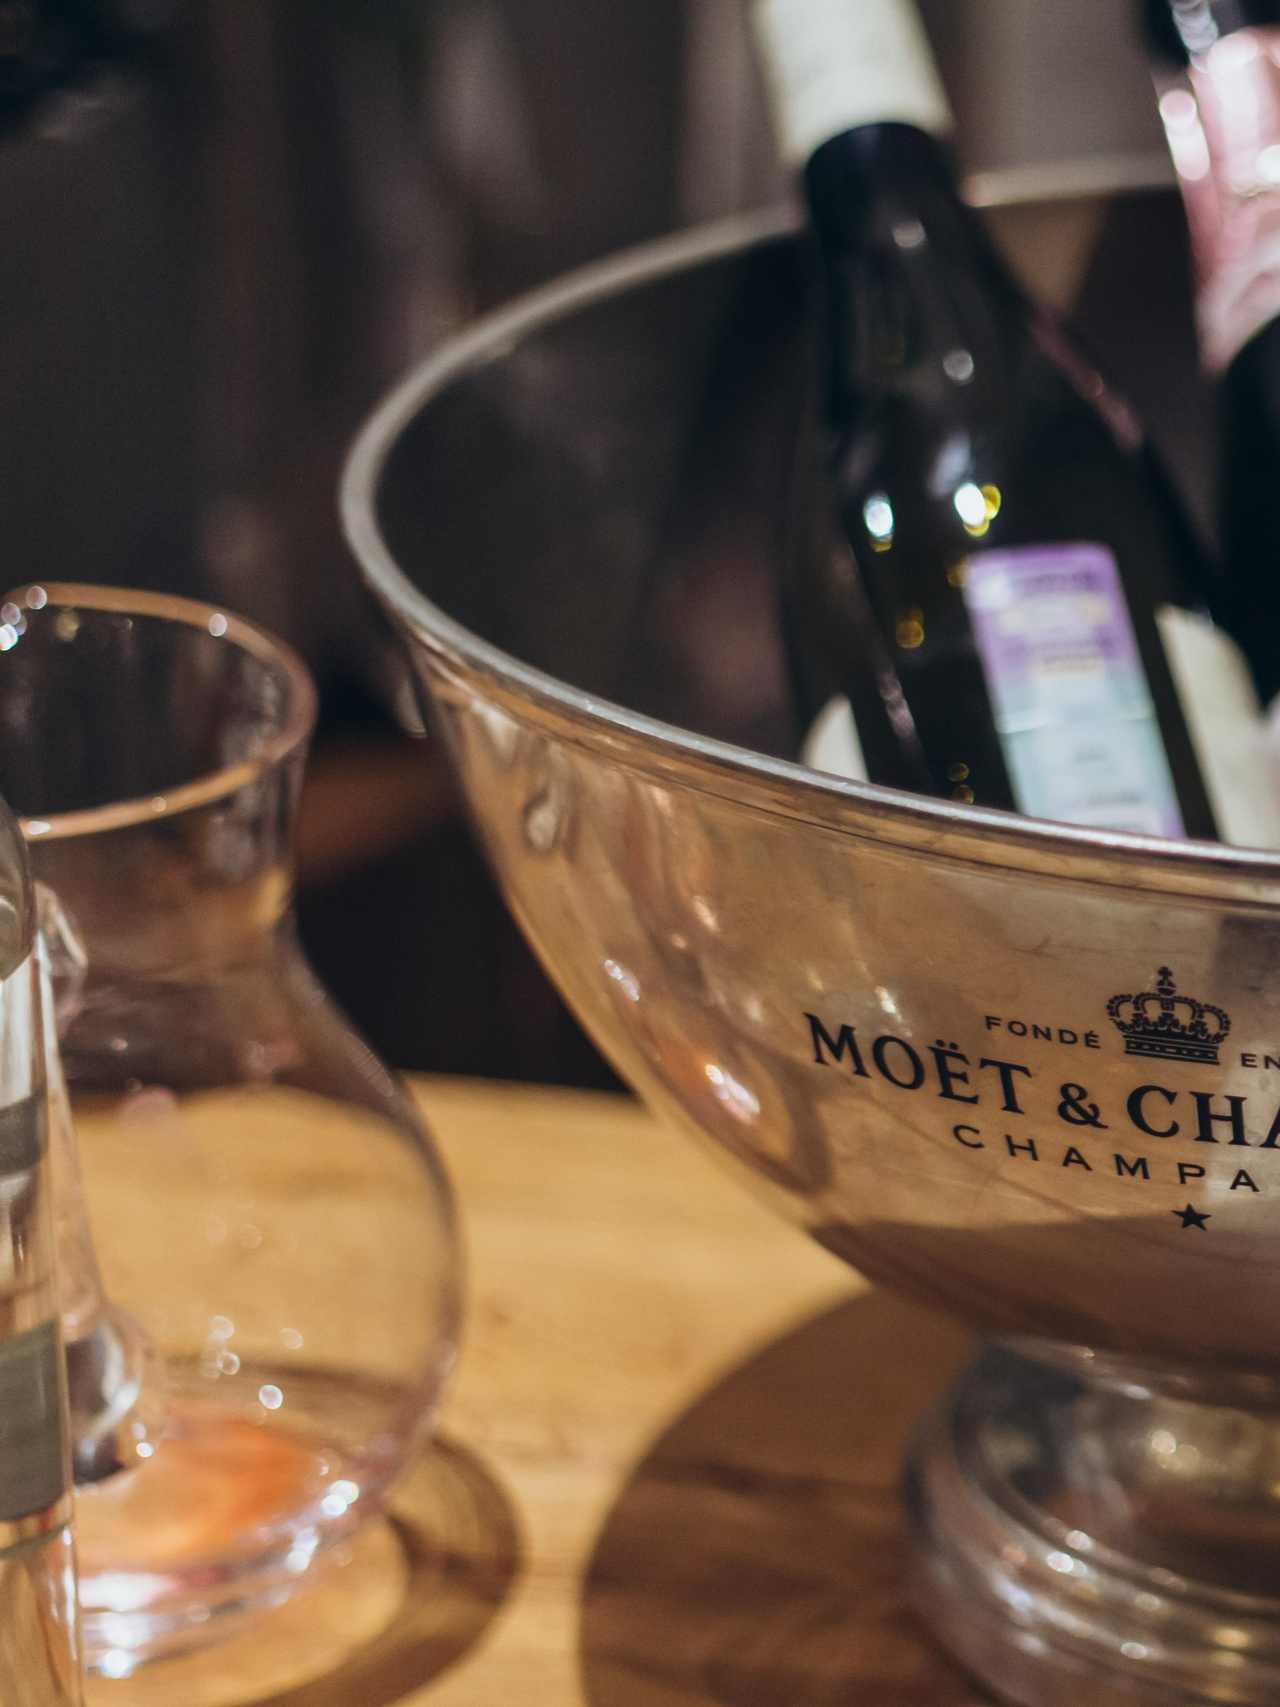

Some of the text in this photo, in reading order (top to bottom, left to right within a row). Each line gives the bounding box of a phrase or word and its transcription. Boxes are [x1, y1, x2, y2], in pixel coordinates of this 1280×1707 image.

[985, 1013, 1102, 1049] FONDÉ
[804, 1012, 1032, 1115] MOËT
[1058, 1081, 1108, 1130] &
